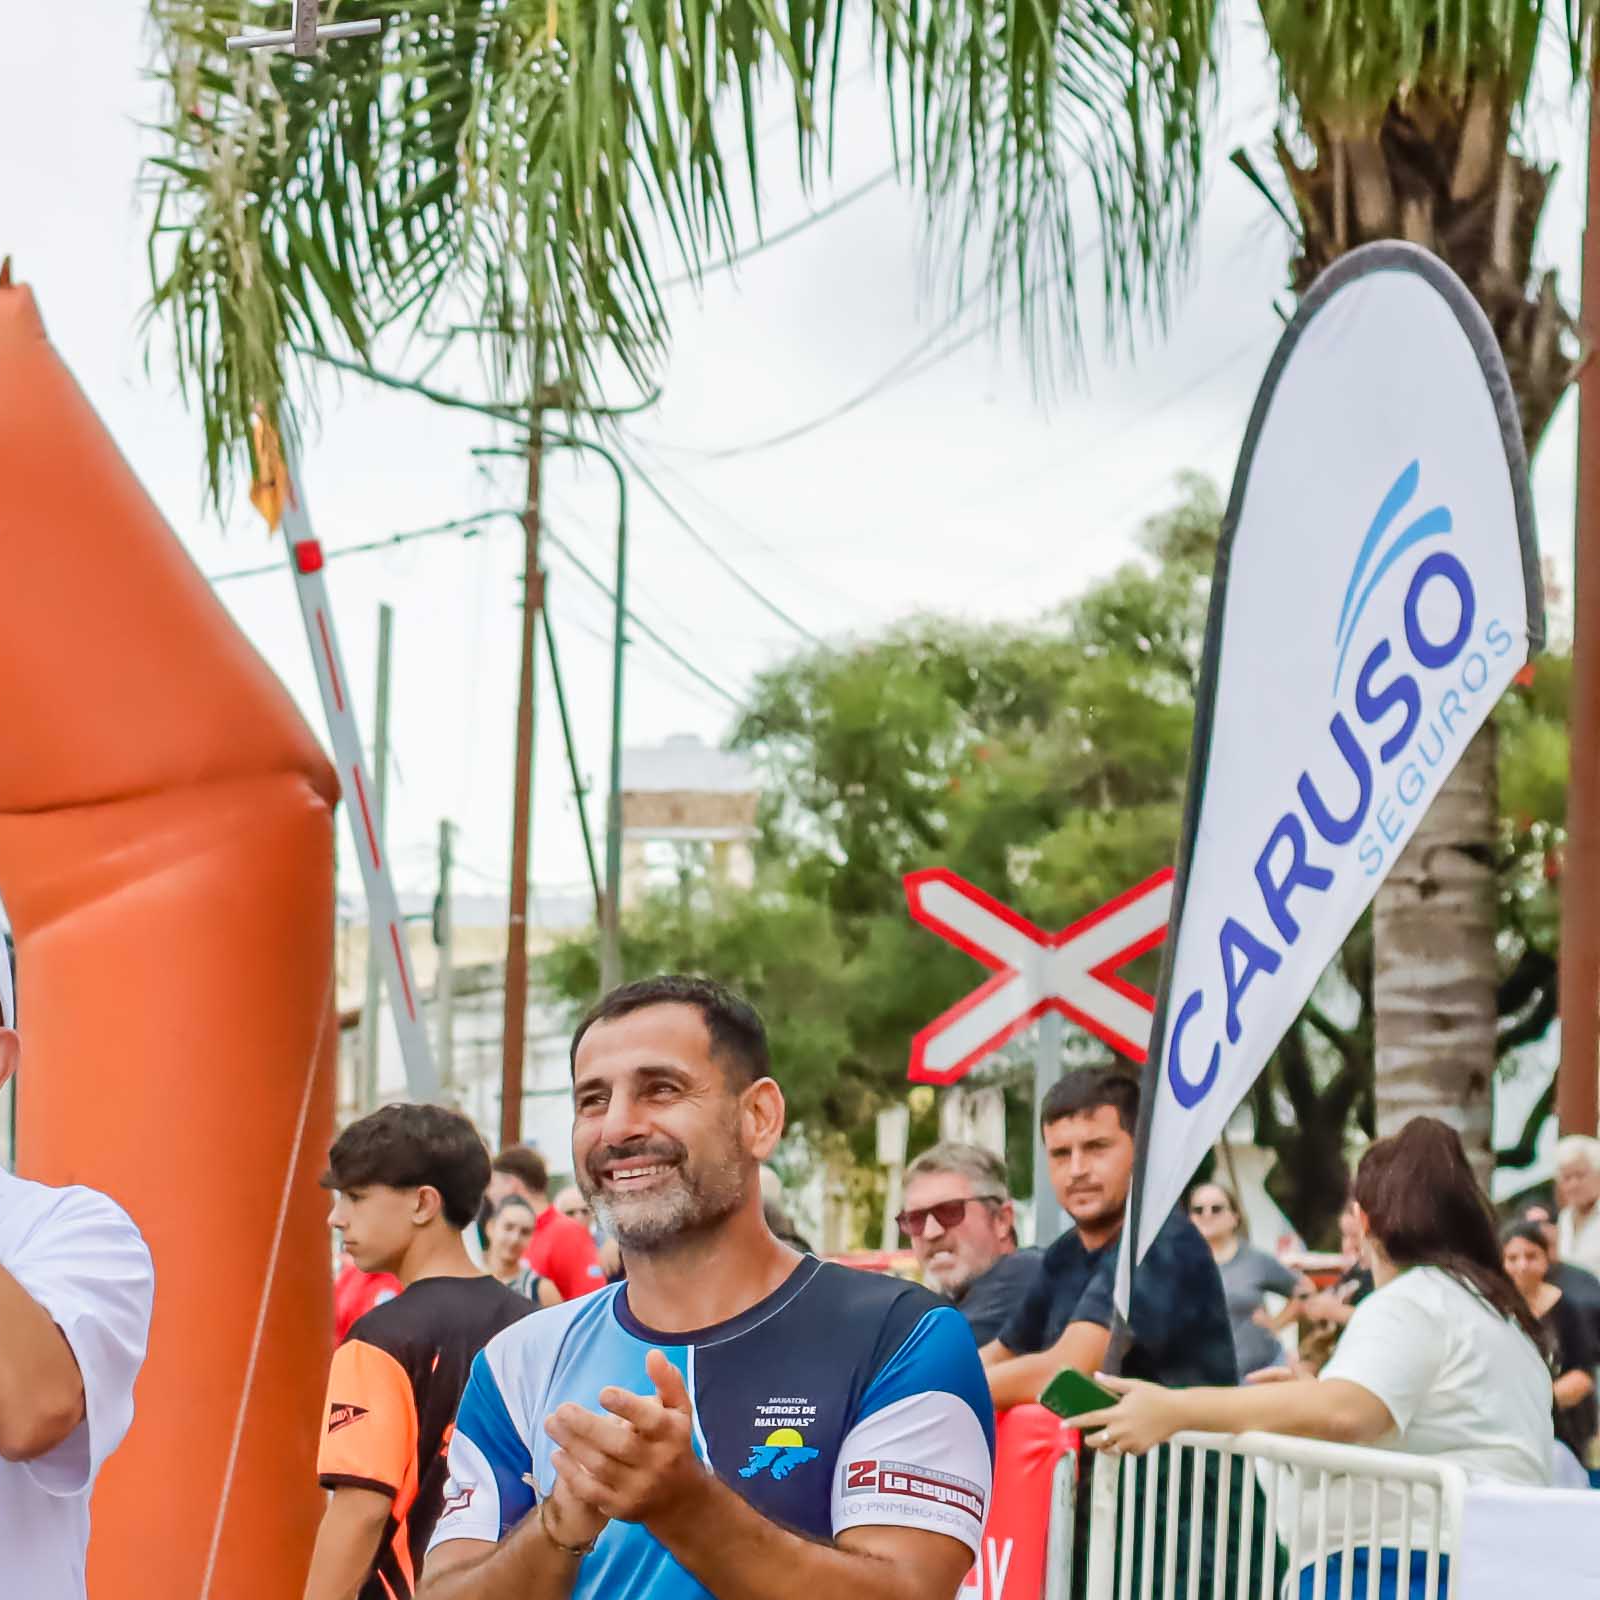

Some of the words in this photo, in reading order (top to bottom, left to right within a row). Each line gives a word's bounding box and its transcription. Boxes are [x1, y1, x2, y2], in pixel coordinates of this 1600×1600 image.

[1358, 618, 1514, 877] SEGUROS
[1167, 552, 1476, 1110] CARUSO
[802, 1405, 817, 1415] DE
[848, 1460, 877, 1489] 2
